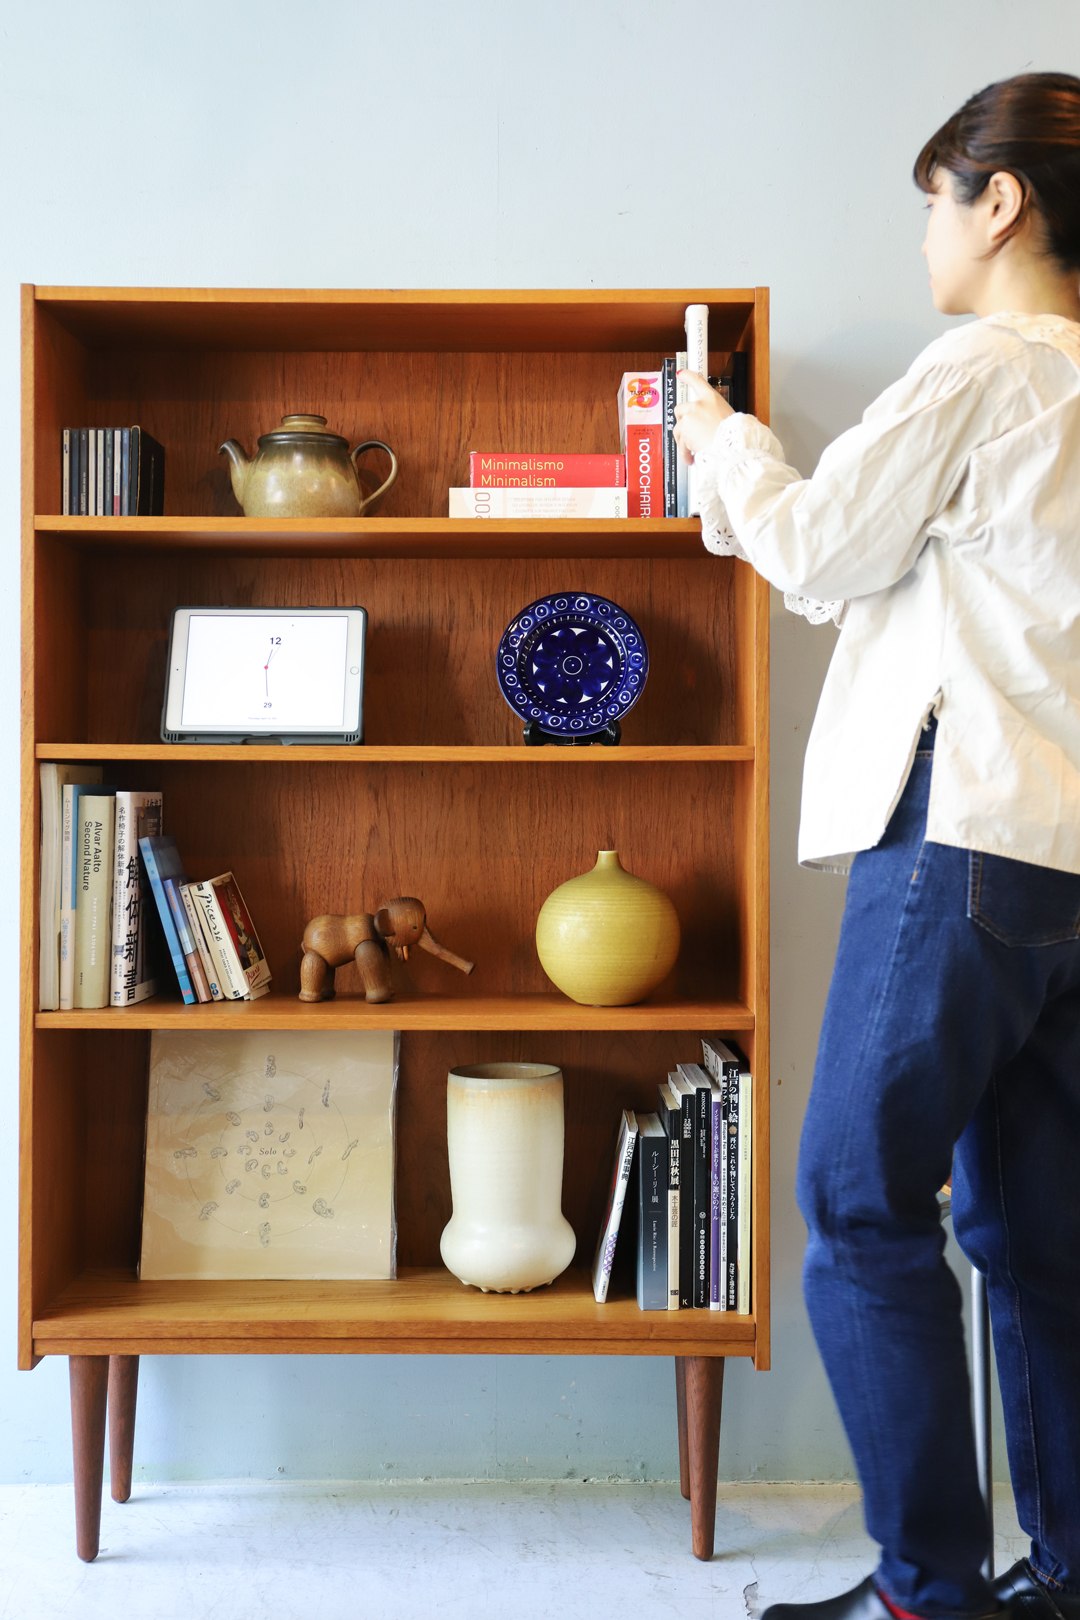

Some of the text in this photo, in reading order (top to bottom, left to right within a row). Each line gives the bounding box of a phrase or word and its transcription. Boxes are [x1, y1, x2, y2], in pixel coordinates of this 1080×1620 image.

[627, 378, 660, 408] 25
[481, 458, 564, 471] Minimalismo
[481, 474, 556, 487] Minimalism
[639, 438, 651, 518] 1000CHAIR
[270, 637, 282, 645] 12
[82, 821, 93, 891] Second Nature
[93, 821, 103, 873] Alvar Aalto
[117, 806, 126, 877] 名作椅子の解体新書
[728, 1068, 739, 1123] 江戸の判じ絵
[259, 1147, 277, 1156] Solo
[670, 1139, 680, 1186] 黒田辰秋展
[651, 1150, 659, 1204] ルーシー・リー展
